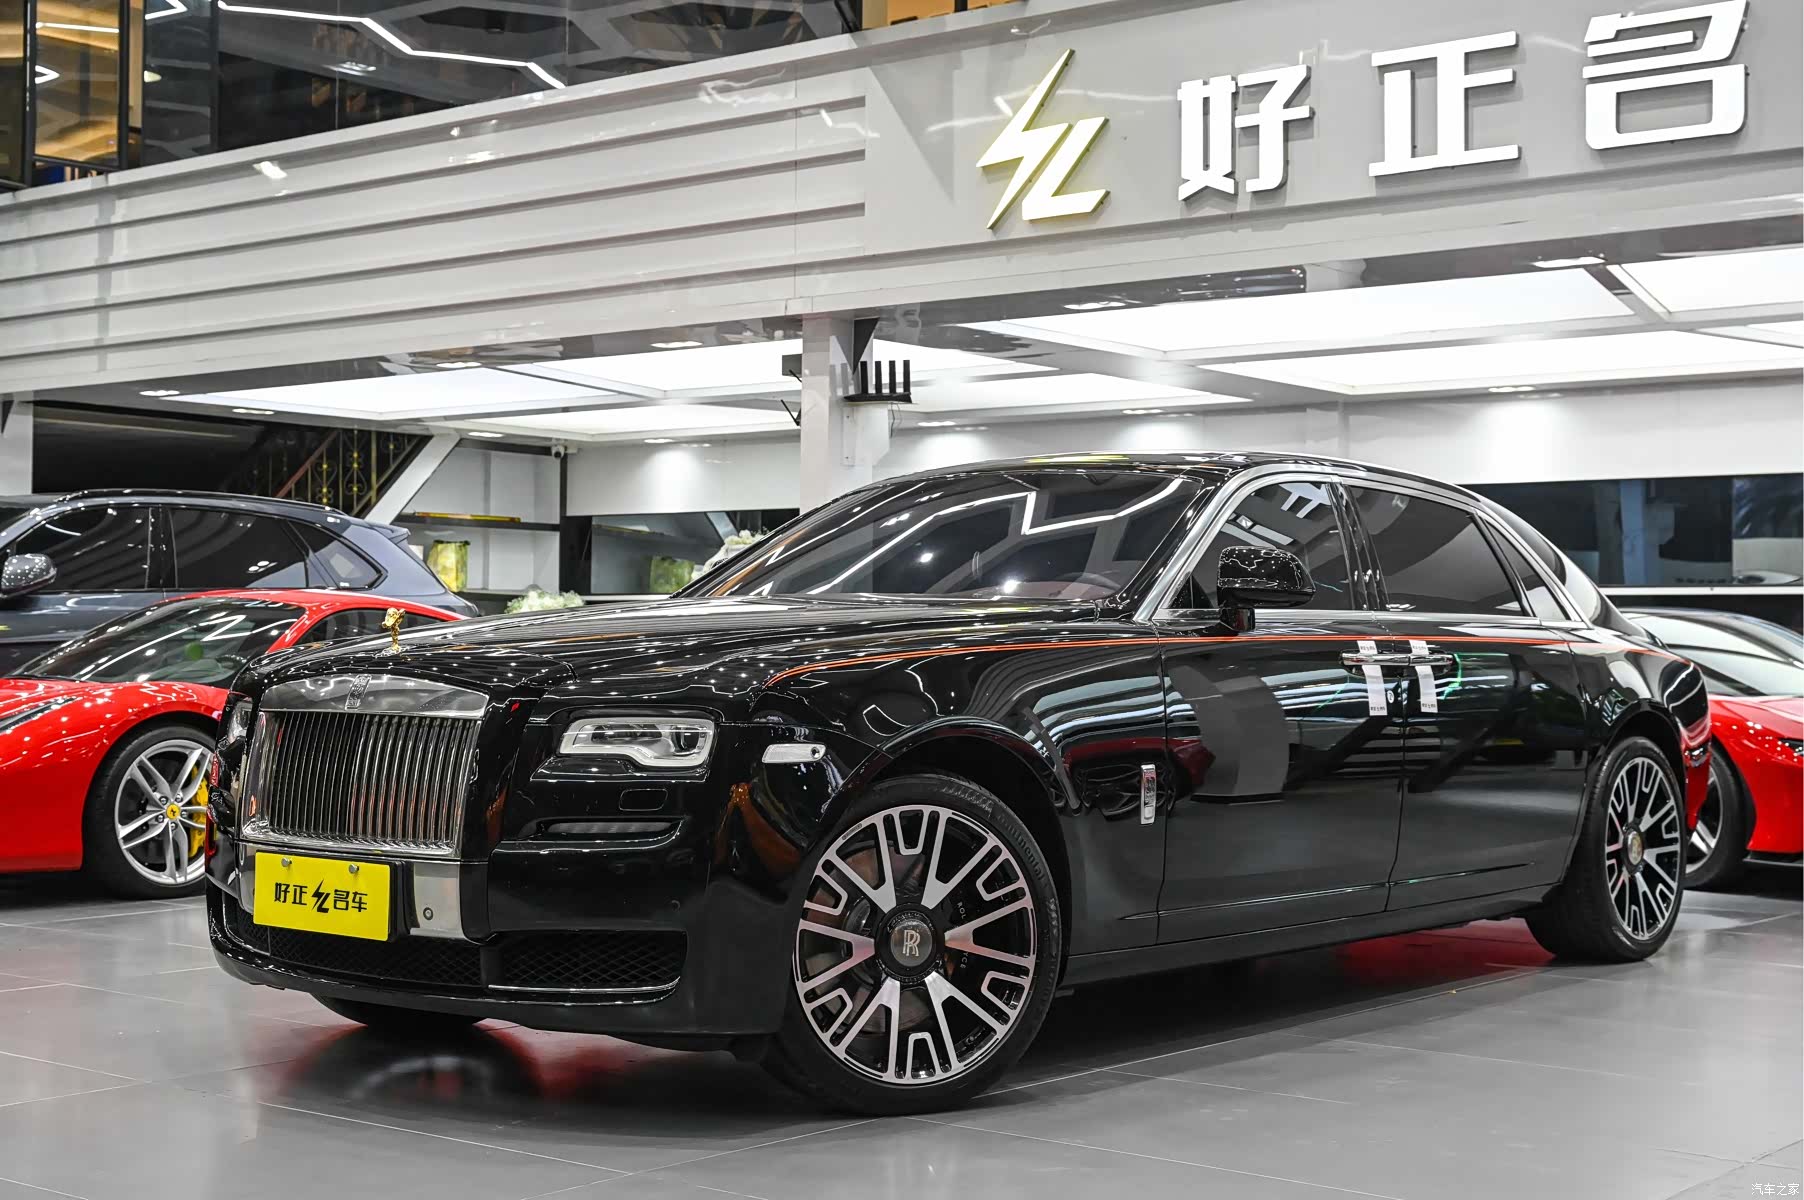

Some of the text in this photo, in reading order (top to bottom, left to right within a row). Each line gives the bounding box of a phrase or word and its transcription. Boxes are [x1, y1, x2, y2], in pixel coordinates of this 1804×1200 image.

[997, 812, 1046, 881] ntinental
[275, 883, 368, 912] 好正 名车
